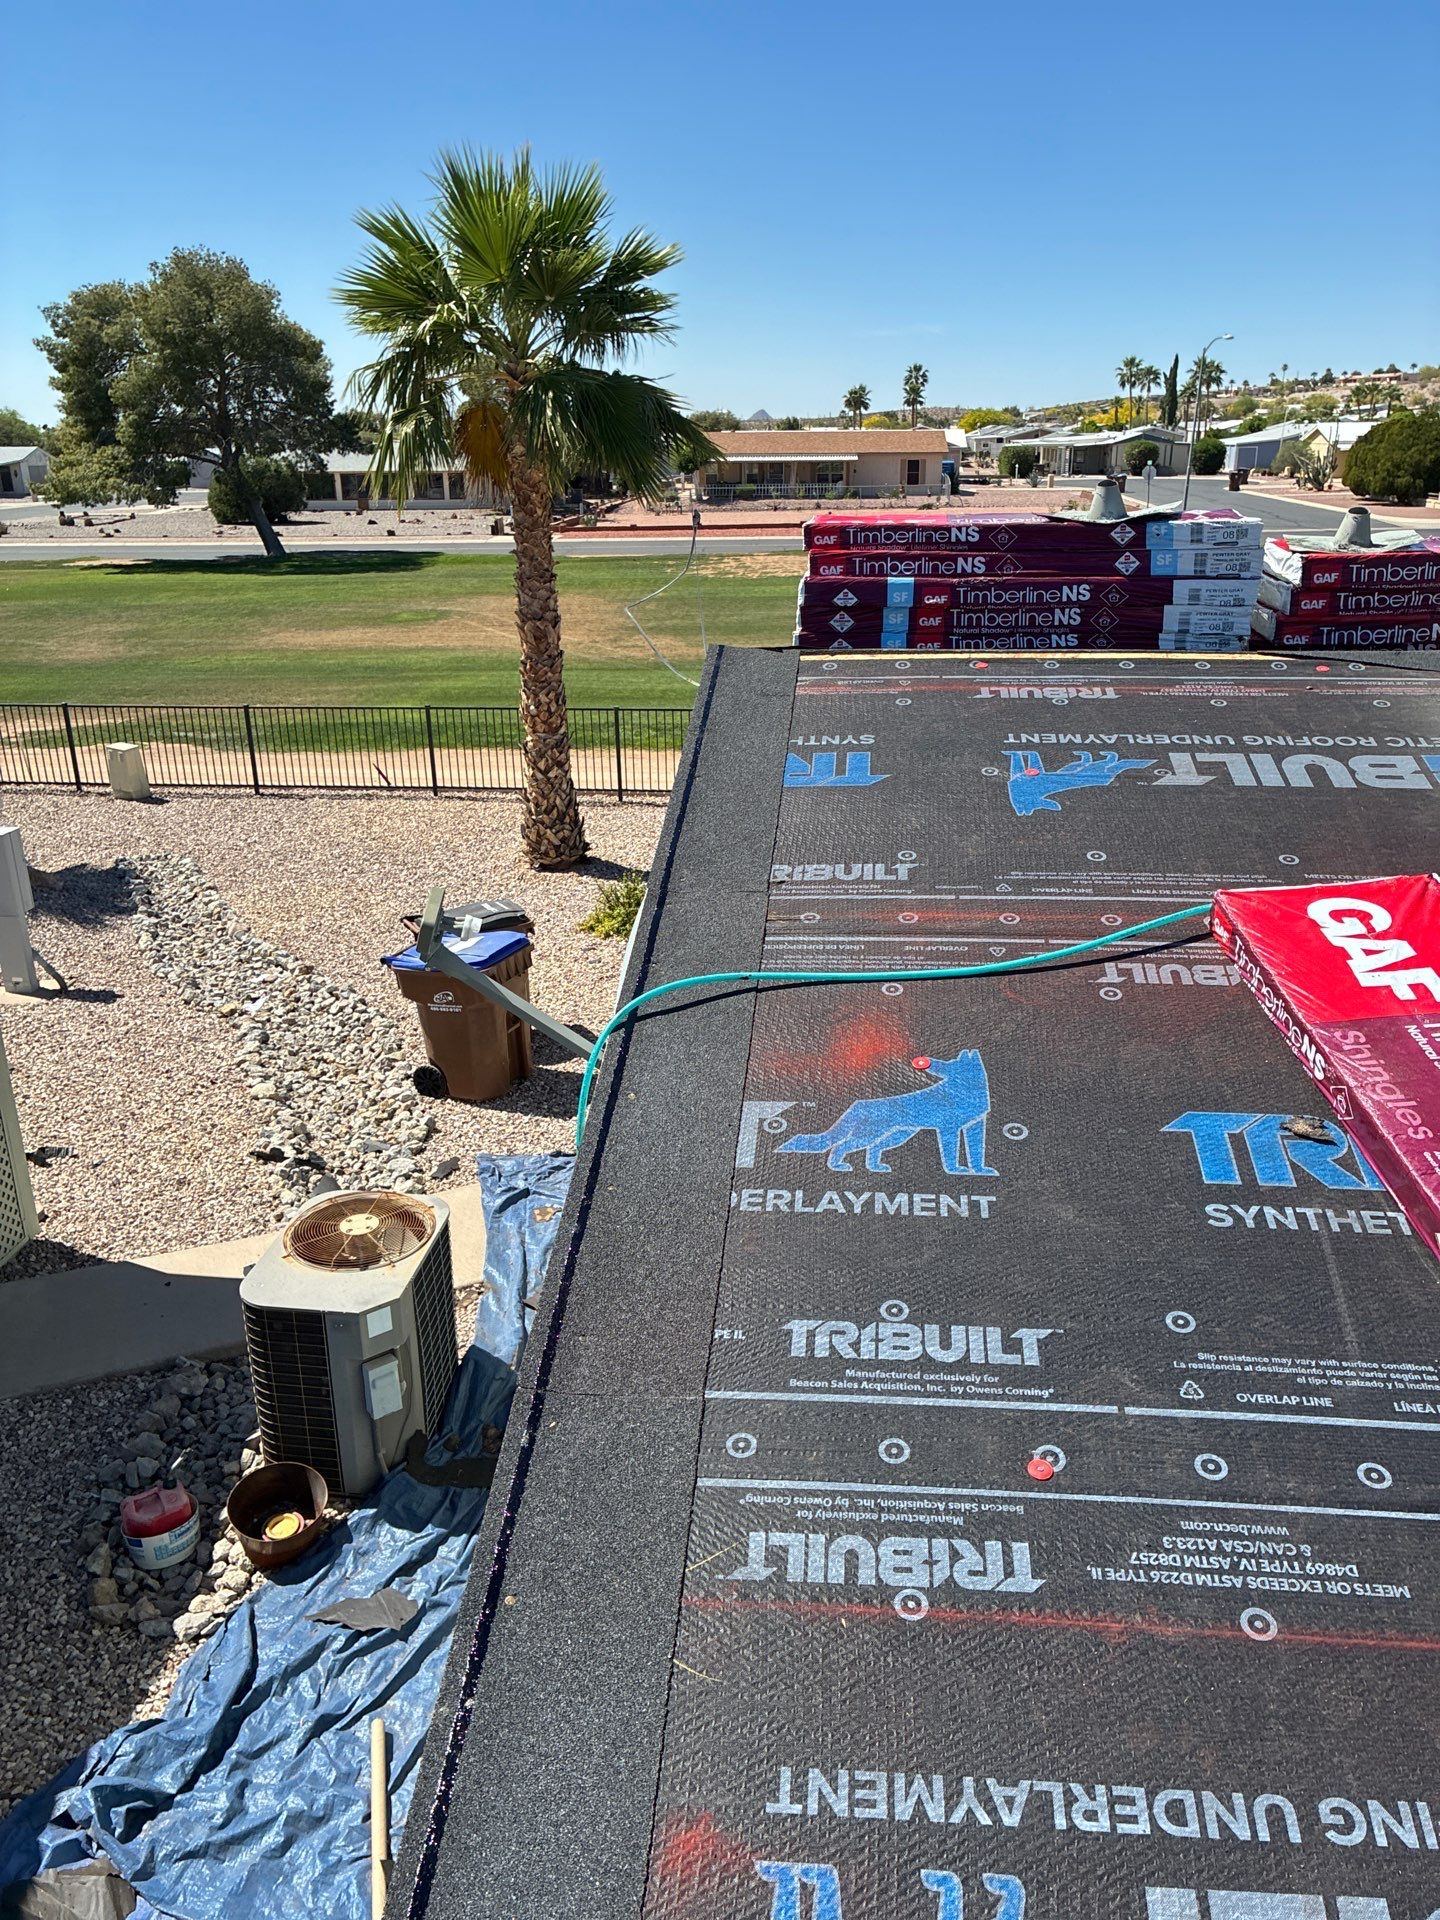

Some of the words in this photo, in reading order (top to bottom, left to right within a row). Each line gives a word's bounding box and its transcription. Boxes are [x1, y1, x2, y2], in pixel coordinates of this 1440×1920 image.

[1152, 526, 1168, 536] SF
[1222, 530, 1234, 540] 08
[814, 535, 838, 545] GAF
[1156, 554, 1172, 565] SF
[820, 565, 844, 575] GAF
[1225, 563, 1238, 572] 08
[1314, 573, 1340, 584] GAF
[892, 592, 908, 603] SF
[924, 594, 948, 604] GAF
[1300, 600, 1327, 610] GAF
[889, 614, 904, 624] SF
[918, 617, 942, 626] GAF
[1208, 622, 1221, 631] 08
[1284, 635, 1310, 645] GAF
[1003, 732, 1236, 746] UNDERLAYMENT
[1243, 734, 1374, 747] ROOFING
[1306, 896, 1440, 1003] GAF
[1405, 1024, 1438, 1060] Natural
[1334, 1027, 1434, 1140] Shingles
[732, 1188, 997, 1219] ERLAYMENT
[1197, 1352, 1217, 1363] Slip
[1218, 1354, 1269, 1364] resistance
[1271, 1356, 1293, 1366] may
[1294, 1358, 1318, 1368] vary
[1318, 1357, 1340, 1368] with
[1342, 1359, 1379, 1370] surface
[1381, 1361, 1438, 1373] conditions,
[846, 1368, 920, 1381] Manufactured
[922, 1371, 982, 1384] exclusively
[984, 1373, 1000, 1384] for
[1174, 1361, 1186, 1369] La
[1188, 1361, 1242, 1372] resistencia
[1244, 1364, 1254, 1372] al
[1256, 1364, 1324, 1376] deslizamiento
[1326, 1369, 1357, 1378] puede
[1358, 1371, 1388, 1380] variar
[1390, 1372, 1422, 1382] según
[1422, 1373, 1439, 1382] las
[790, 1378, 828, 1389] Beacon
[830, 1379, 859, 1390] Sales
[860, 1380, 925, 1394] Acquisition,
[927, 1383, 946, 1393] Inc.
[950, 1384, 964, 1396] by
[966, 1385, 1003, 1396] Owens
[1296, 1376, 1306, 1385] el
[1308, 1376, 1328, 1386] tipo
[1330, 1378, 1343, 1386] de
[1345, 1378, 1384, 1388] calzado
[1386, 1382, 1393, 1390] y
[1394, 1381, 1405, 1390] la
[1236, 1392, 1300, 1407] OVERLAP
[1302, 1396, 1334, 1408] LINE
[1393, 1400, 1437, 1414] LÍNEA
[794, 1496, 832, 1507] Owens
[834, 1496, 849, 1508] by
[854, 1498, 874, 1509] Inc.
[877, 1498, 946, 1512] Acquisition,
[948, 1502, 978, 1512] Sales
[796, 1510, 813, 1520] for
[815, 1510, 878, 1522] exclusively
[981, 1504, 1024, 1514] Beacon
[880, 1512, 964, 1526] Manufactured
[1179, 1520, 1289, 1537] www.becn.com
[1162, 1536, 1218, 1552] A123.3
[1220, 1538, 1298, 1556] CAN/CSA
[1300, 1543, 1312, 1558] &
[1128, 1550, 1180, 1566] D8257
[1184, 1554, 1231, 1570] ASTM
[1234, 1555, 1258, 1571] IV,
[1086, 1563, 1102, 1580] II,
[1260, 1558, 1304, 1574] TYPE
[1306, 1562, 1360, 1577] D4869
[1104, 1566, 1146, 1582] TYPE
[1150, 1570, 1192, 1584] D226
[1194, 1572, 1244, 1588] ASTM
[1247, 1576, 1321, 1592] EXCEEDS
[1326, 1579, 1352, 1595] OR
[1353, 1583, 1412, 1599] MEETS
[766, 1766, 1302, 1844] UNDERLAYMENT
